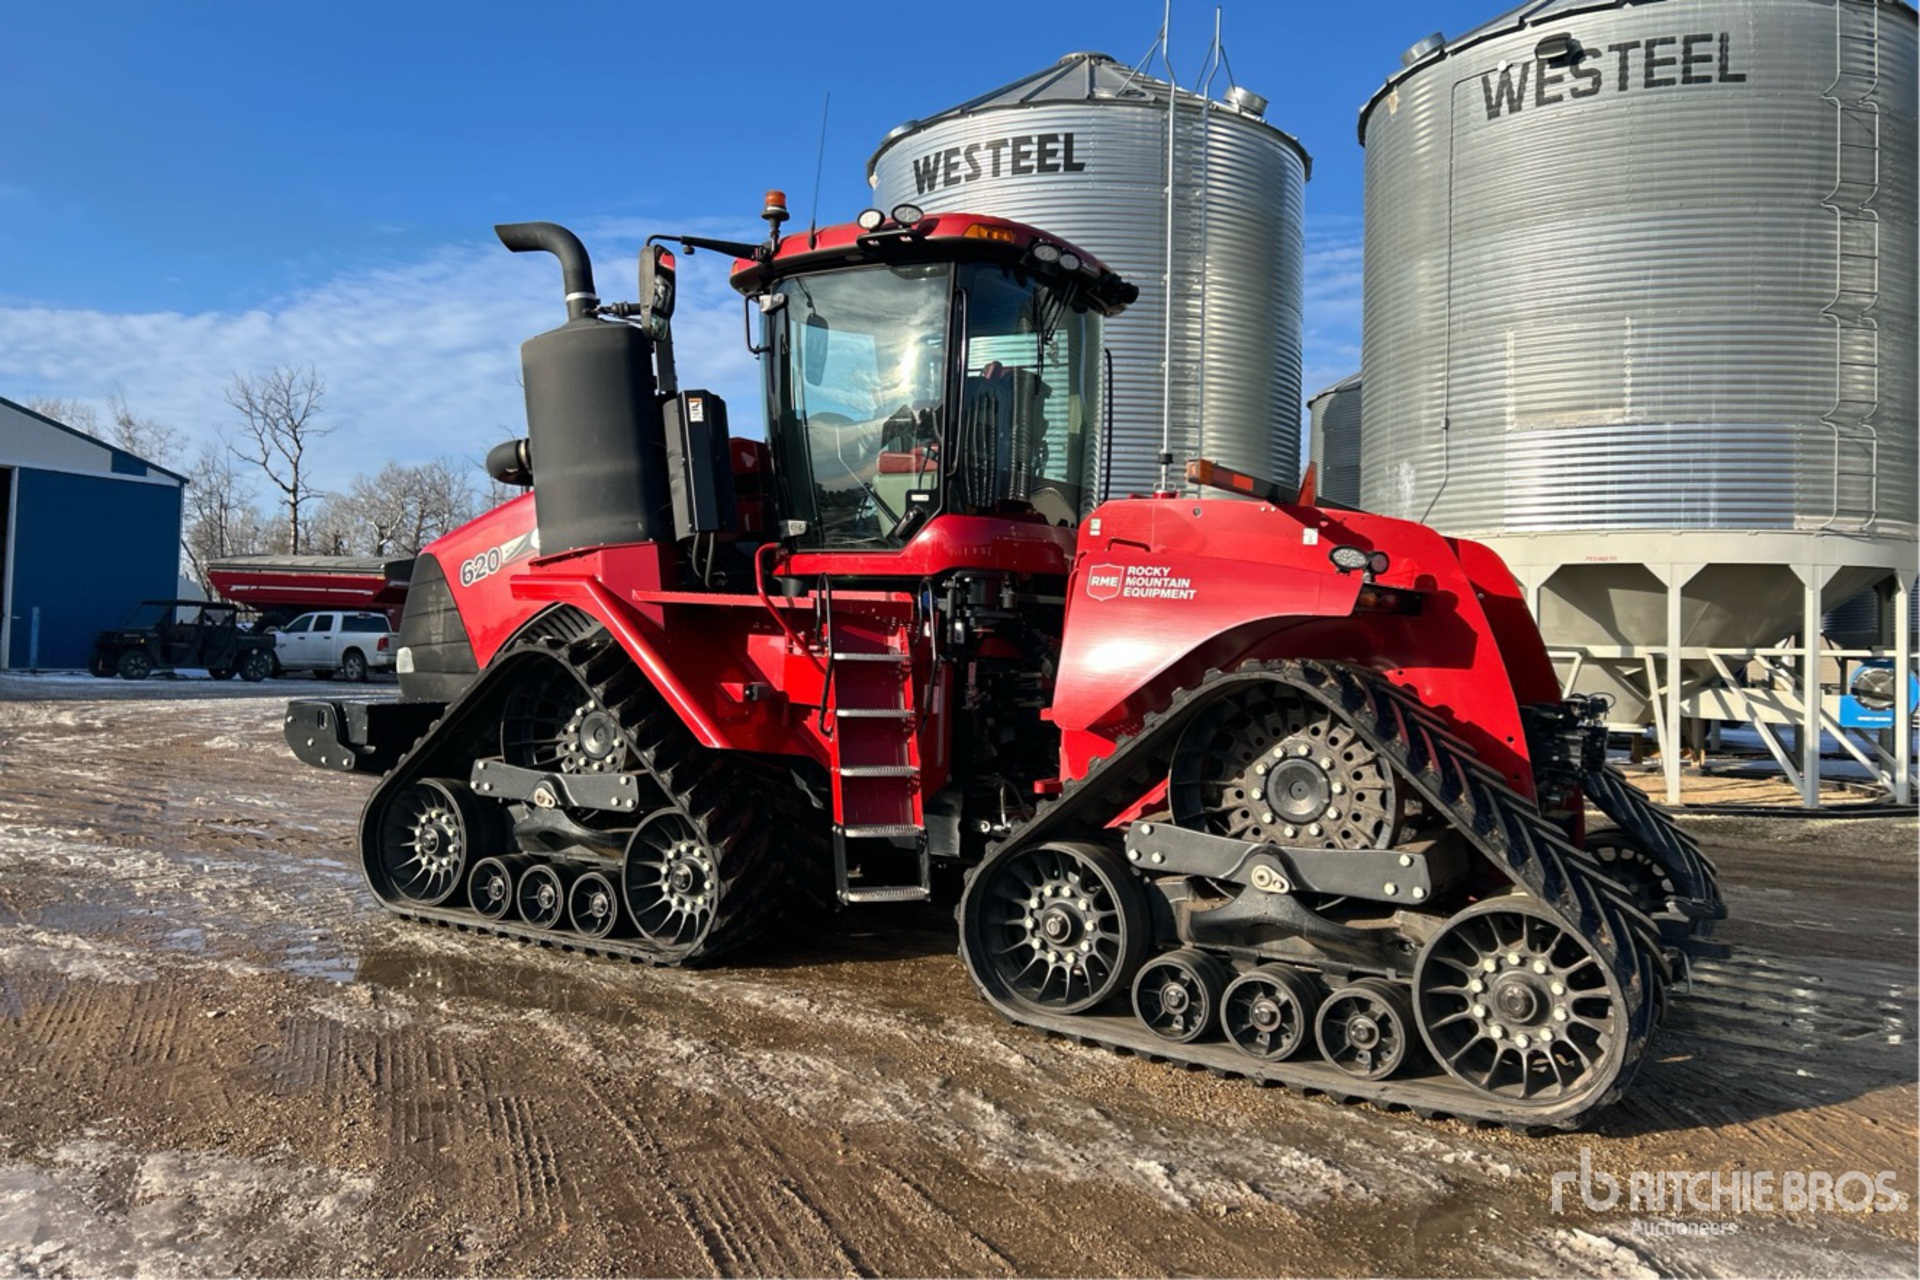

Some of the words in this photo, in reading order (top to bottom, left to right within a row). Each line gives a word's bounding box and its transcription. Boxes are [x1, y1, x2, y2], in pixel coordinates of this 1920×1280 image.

[1481, 32, 1747, 121] WESTEEL
[913, 132, 1086, 195] WESTEEL
[460, 546, 501, 587] 620
[1127, 566, 1171, 577] ROCKY
[1090, 575, 1119, 587] RME
[1125, 576, 1190, 588] MOUNTAIN
[1123, 587, 1197, 600] EQUIPMENT
